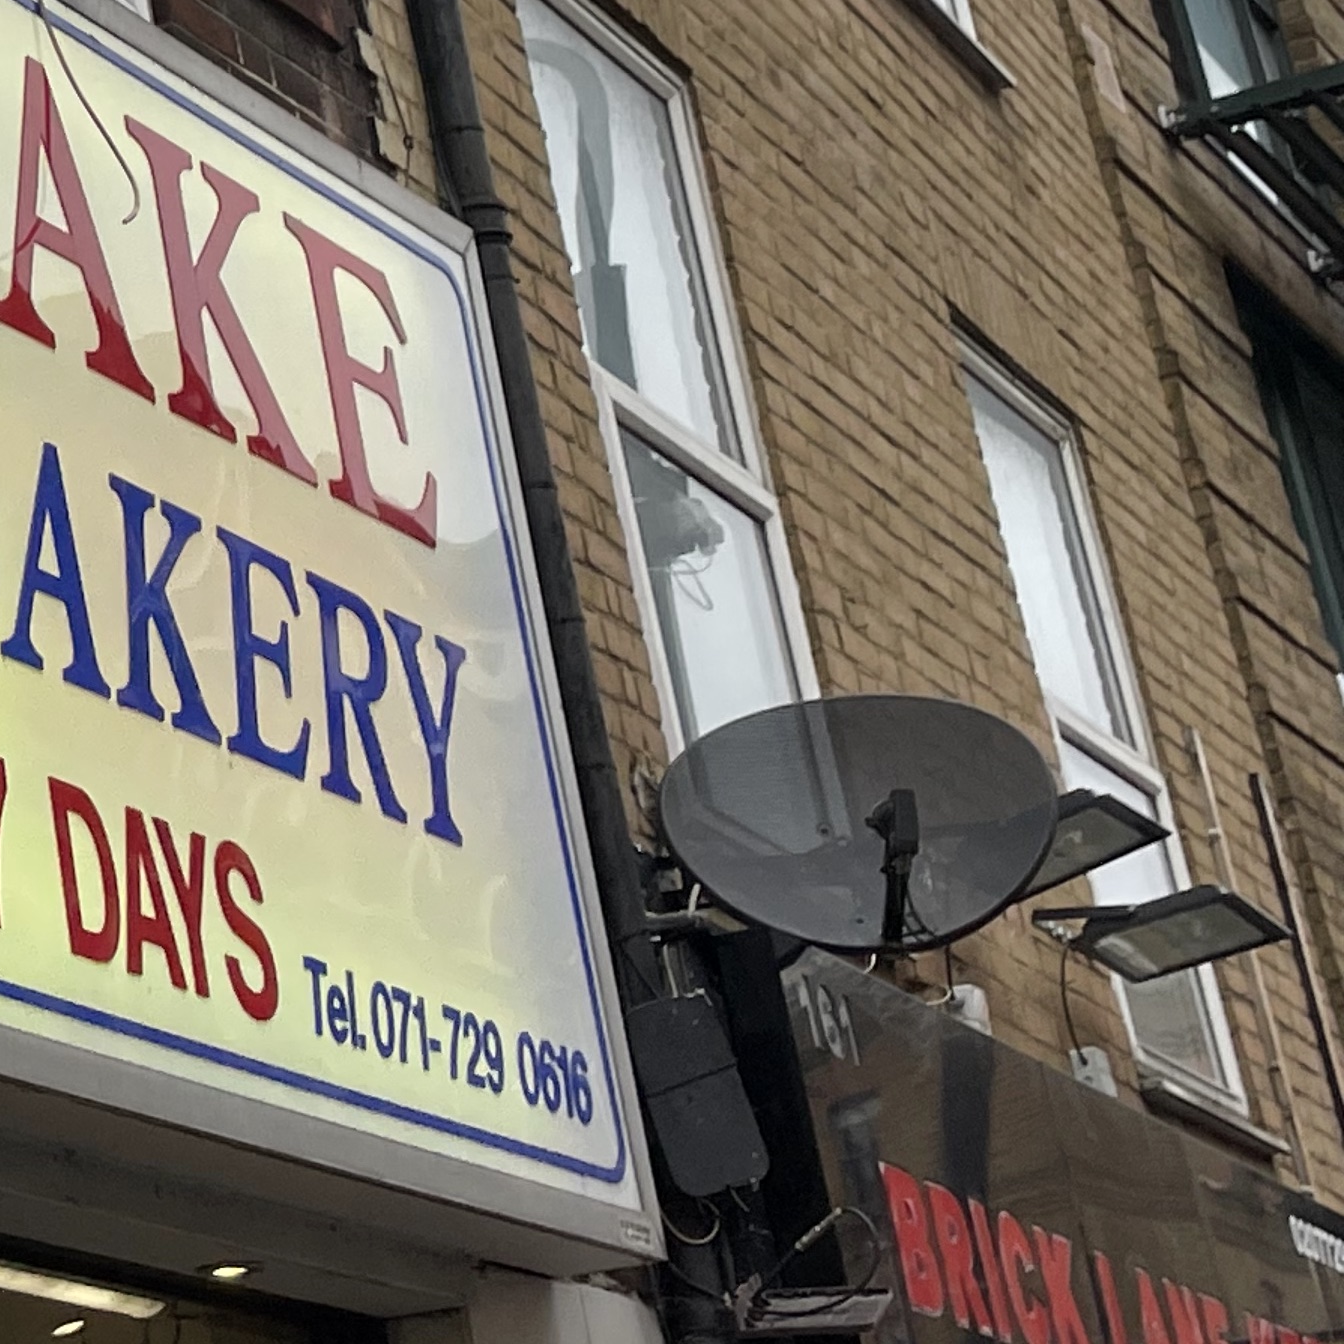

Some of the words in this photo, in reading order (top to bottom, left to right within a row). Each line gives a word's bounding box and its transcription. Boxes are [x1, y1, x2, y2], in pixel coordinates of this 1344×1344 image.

[47, 776, 278, 1021] DAYS
[517, 1031, 593, 1126] 0616
[879, 1160, 1090, 1344] BRICK
